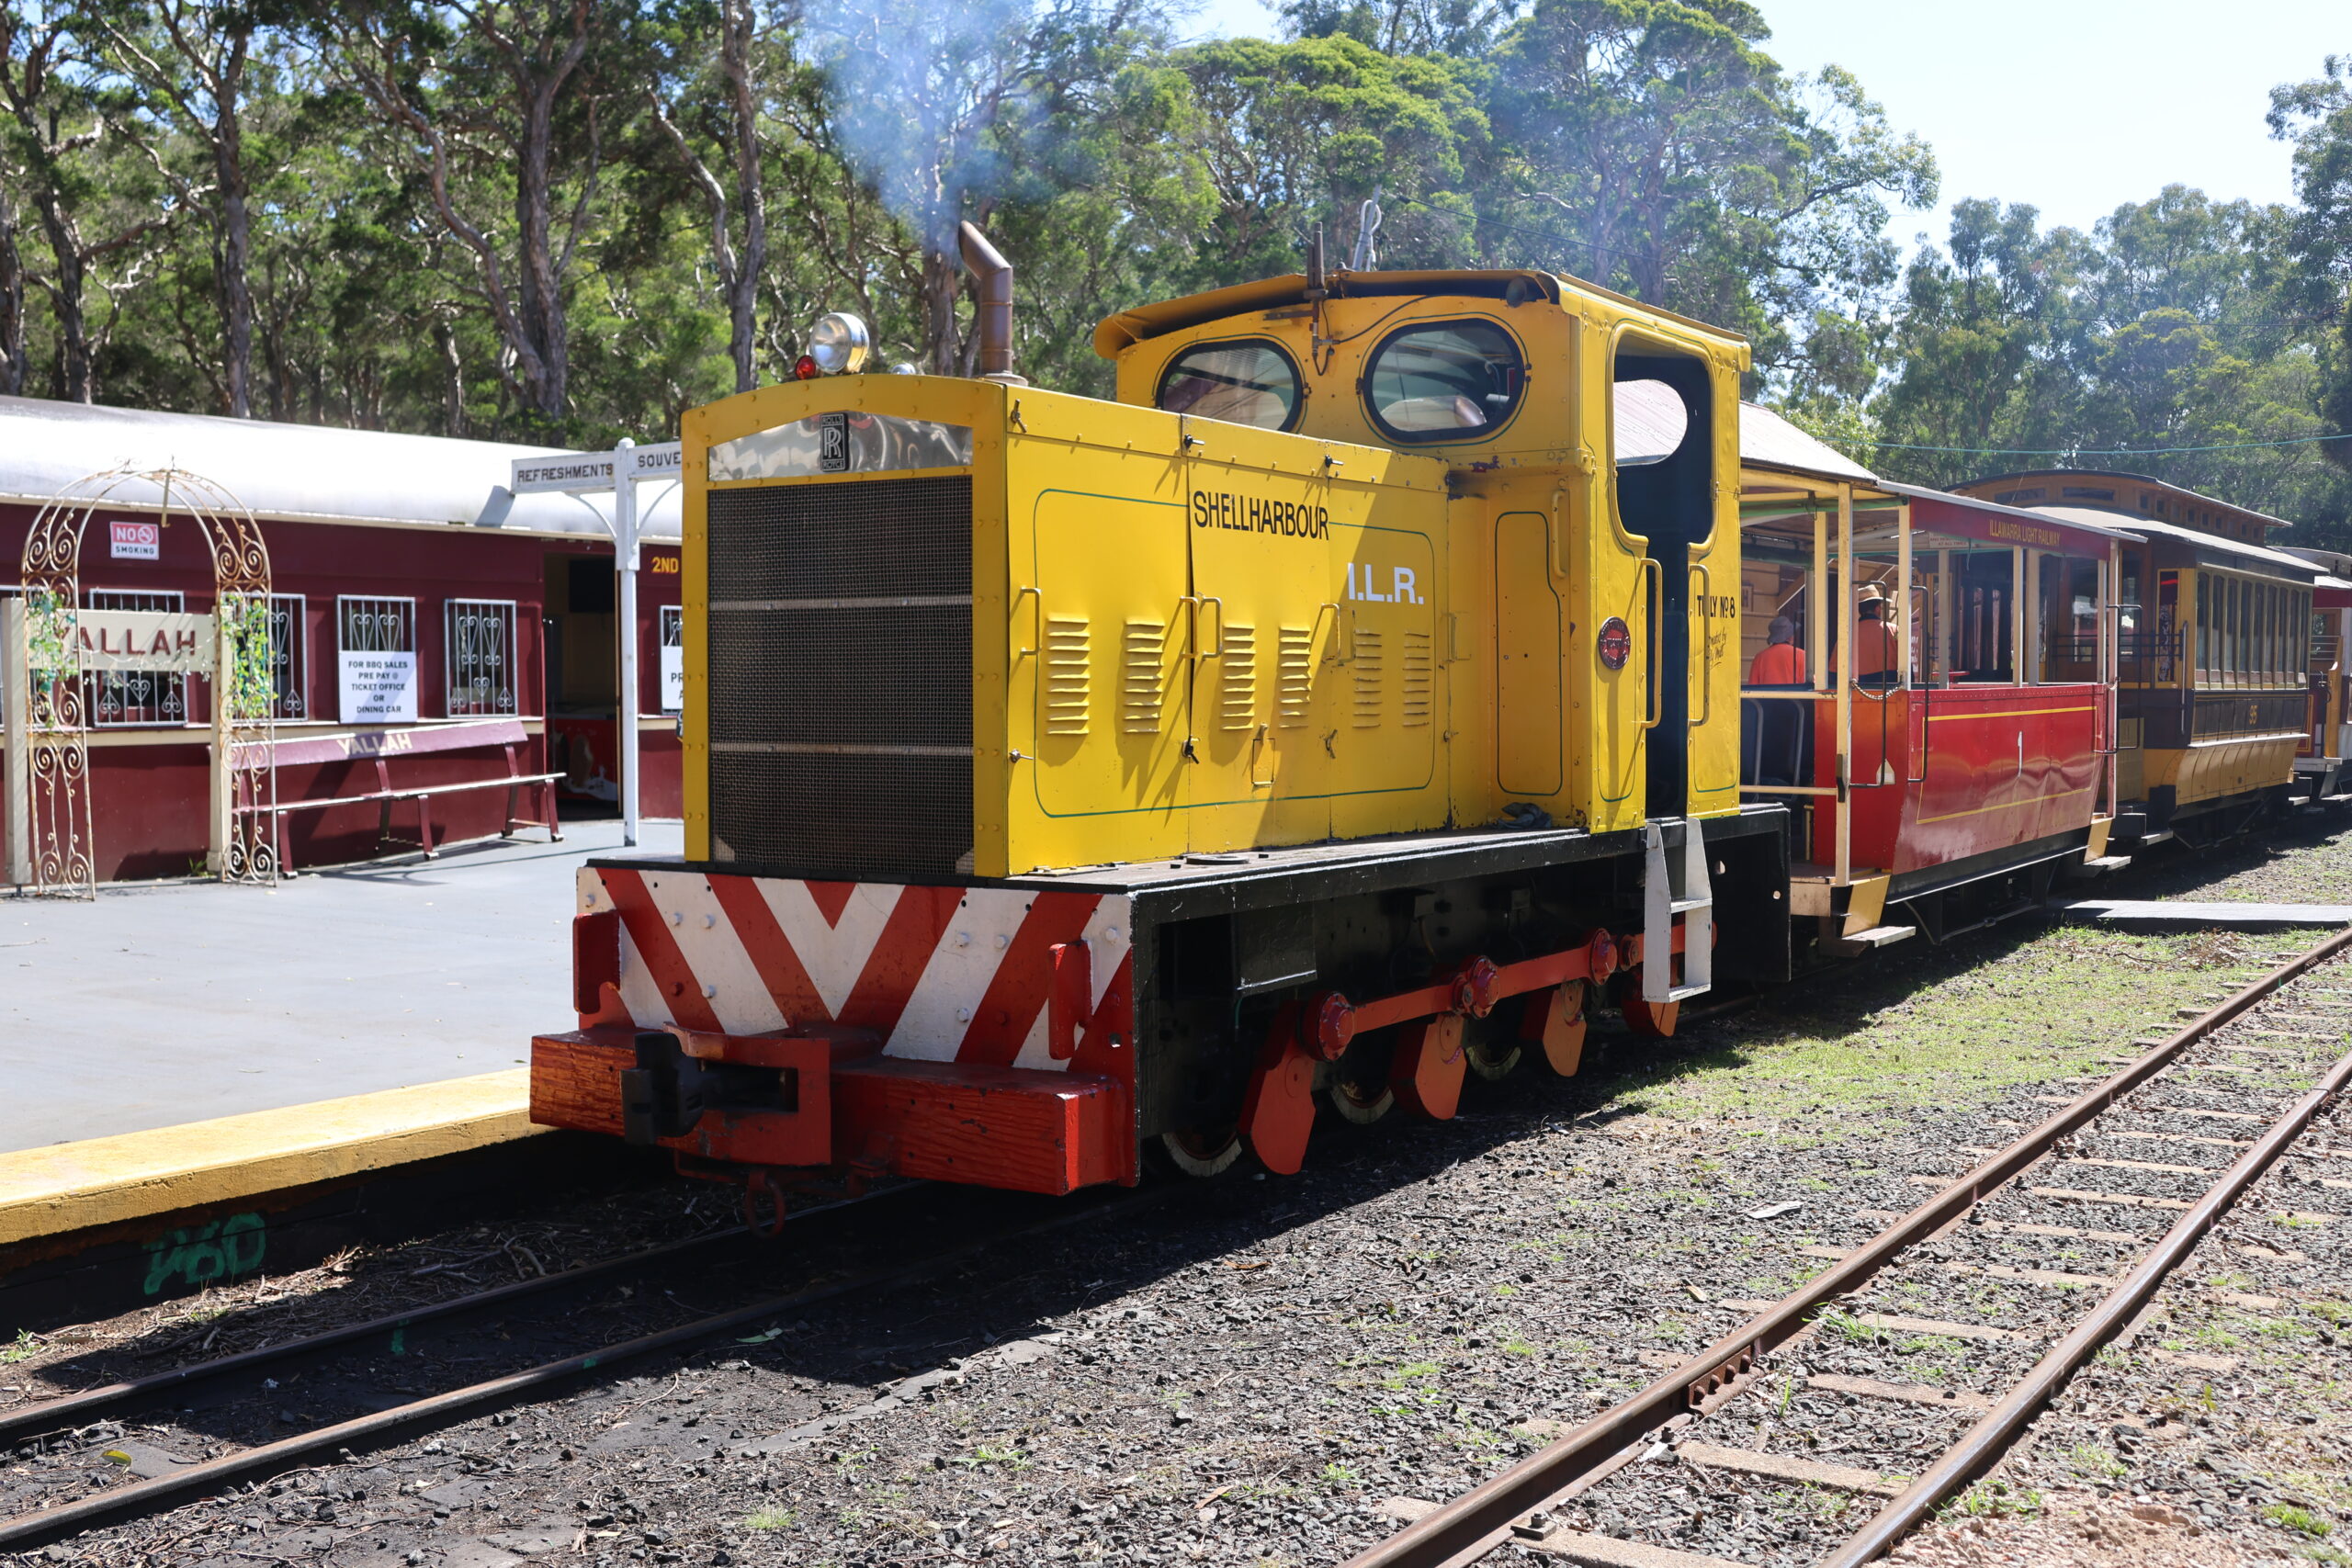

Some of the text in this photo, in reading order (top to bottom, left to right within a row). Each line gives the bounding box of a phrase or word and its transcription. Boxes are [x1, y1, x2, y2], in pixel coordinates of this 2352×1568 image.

[822, 415, 842, 423] ROLLS
[517, 463, 614, 483] REFRESHMENTS
[823, 460, 843, 468] ROYCE
[1193, 490, 1329, 541] SHELLHARBOUR
[116, 527, 136, 541] NO
[1989, 519, 2061, 547] ILLAWARRA LIGHT RAILWAY
[116, 546, 154, 555] SMOKING
[651, 557, 679, 574] 2ND
[1347, 562, 1425, 605] I.L.R.
[1730, 597, 1736, 618] 8
[356, 705, 384, 714] DINING
[336, 732, 413, 756] YALLAH
